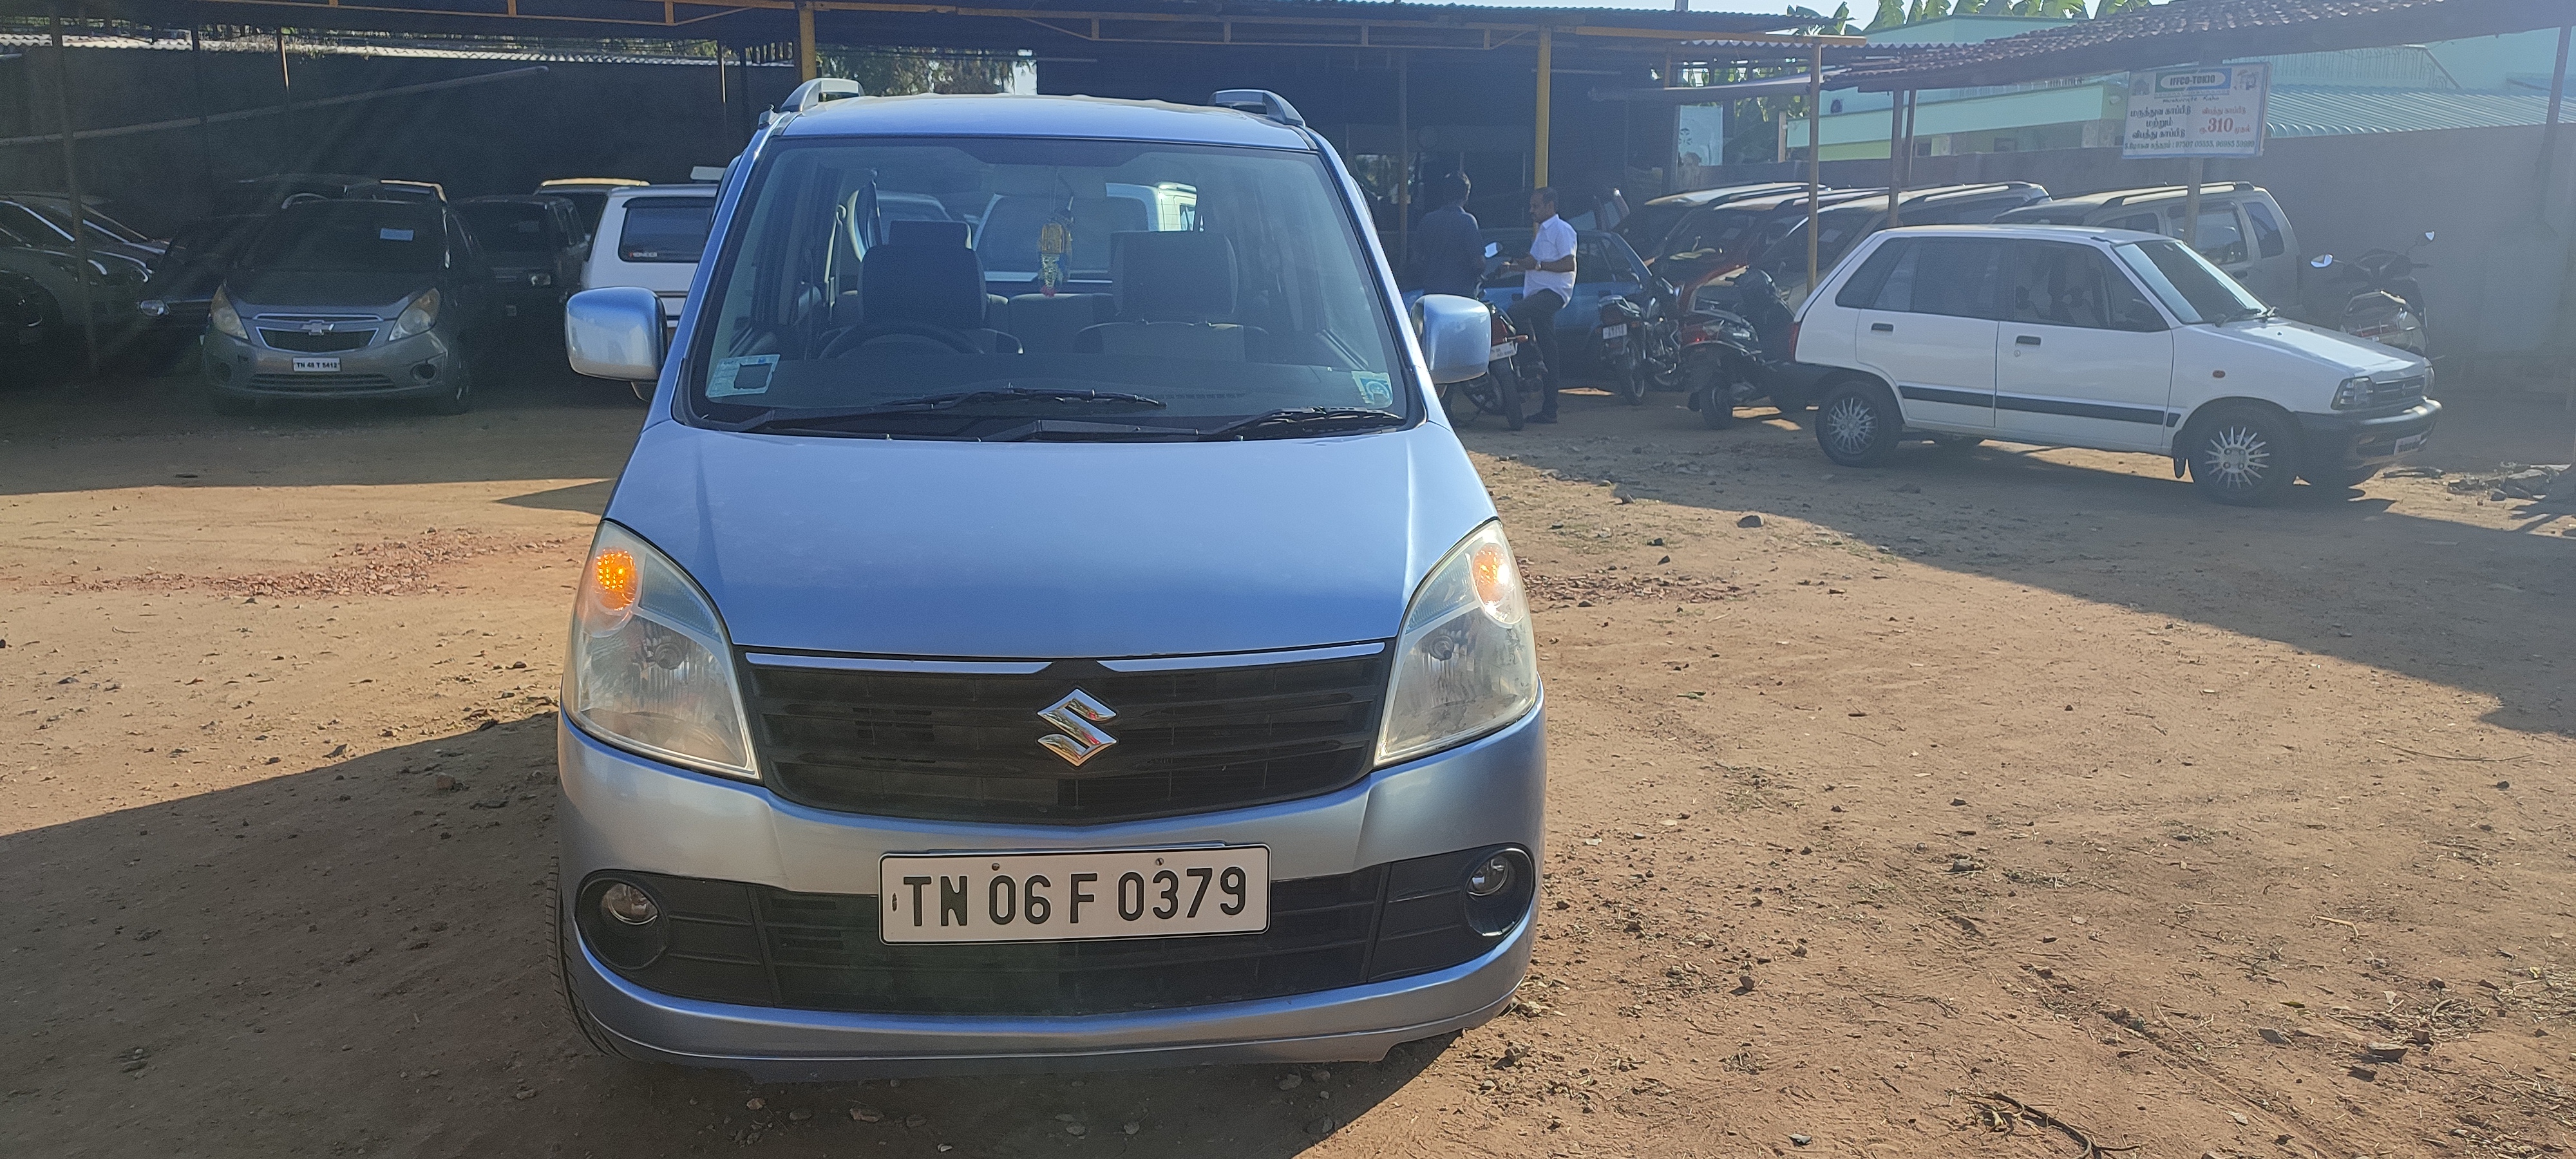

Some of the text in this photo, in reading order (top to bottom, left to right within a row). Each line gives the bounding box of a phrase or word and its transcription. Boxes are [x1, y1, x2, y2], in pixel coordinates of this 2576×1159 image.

[2170, 75, 2215, 86] IFFCO-TOKIO
[903, 866, 1247, 927] TN 06 F 0379
